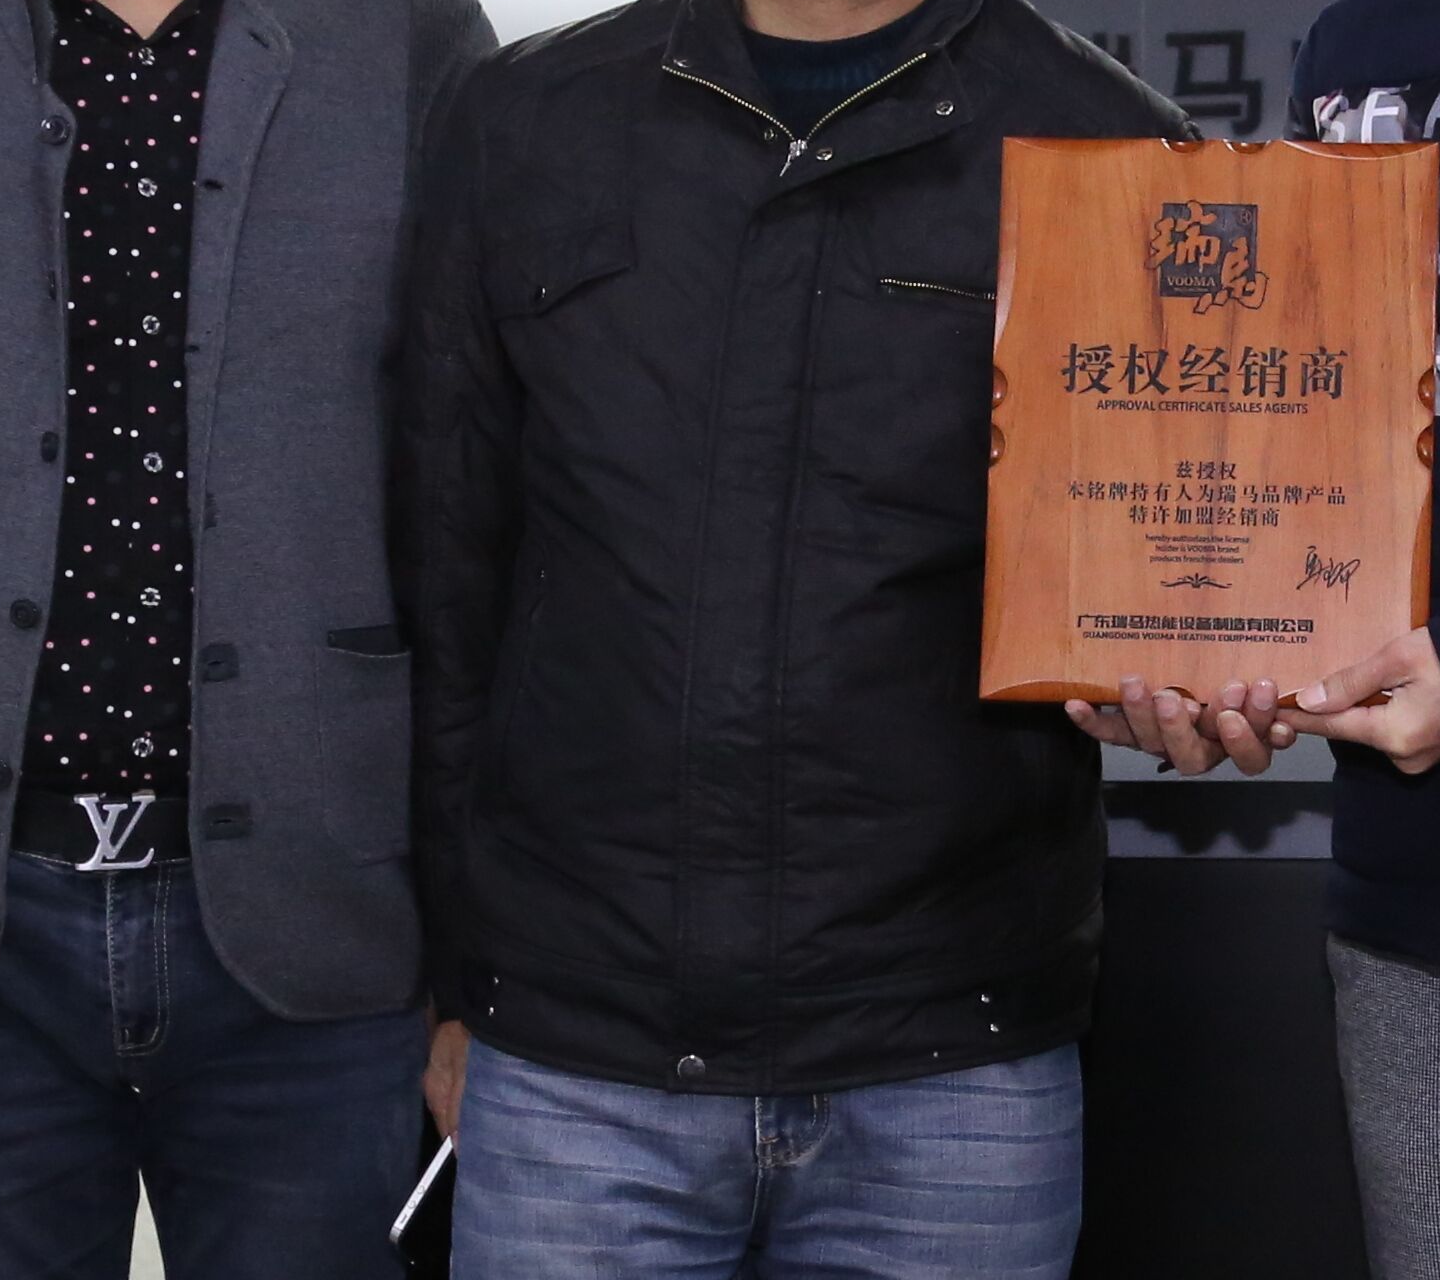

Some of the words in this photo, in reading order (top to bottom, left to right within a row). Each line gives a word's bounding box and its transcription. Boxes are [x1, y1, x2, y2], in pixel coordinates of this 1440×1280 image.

[1167, 275, 1216, 287] VOOMA
[1061, 343, 1348, 400] 授权经销商
[1096, 400, 1156, 412] APPROVAL
[1158, 401, 1227, 413] CERTIFICATE
[1229, 402, 1262, 414] SALES
[1265, 403, 1308, 415] AGENTS
[1174, 460, 1237, 480] 兹授权
[1068, 481, 1346, 505] 本铭牌持有人为瑞马品牌产品
[1129, 504, 1281, 527] 特许加盟经销商
[1142, 632, 1175, 641] VOOMA
[1177, 633, 1216, 641] HEATING
[1218, 634, 1271, 643] EQUIPMENT
